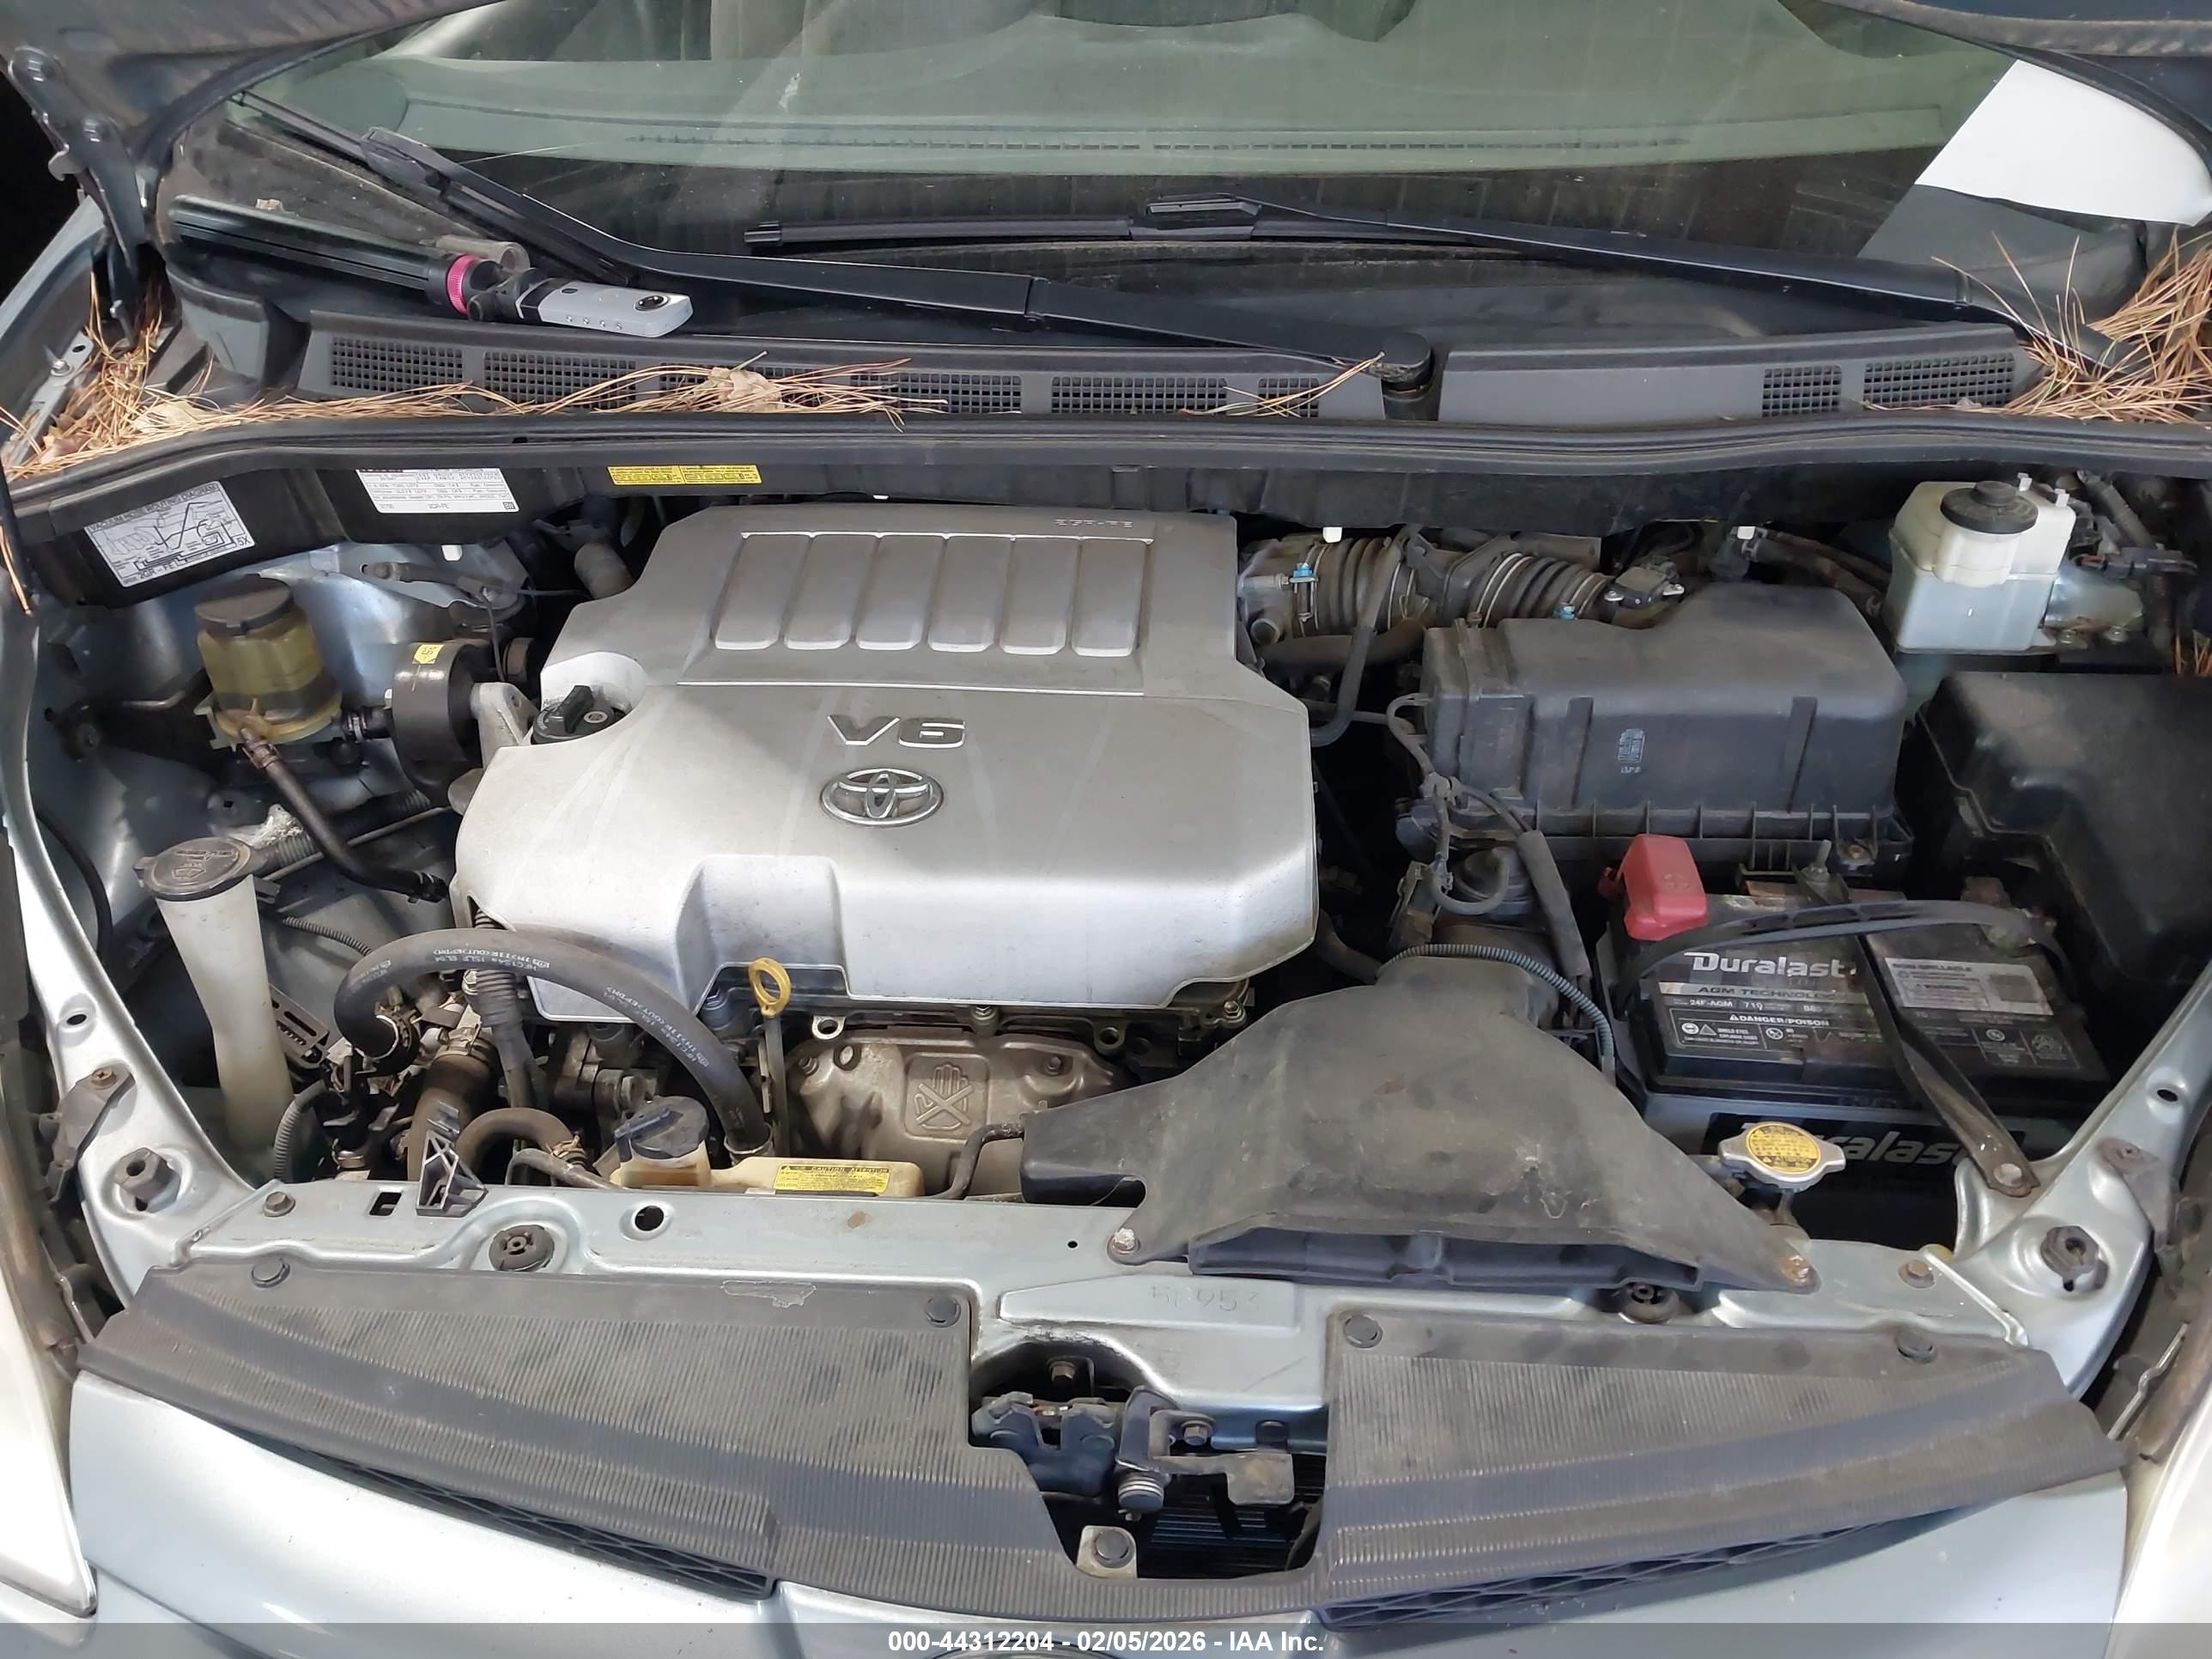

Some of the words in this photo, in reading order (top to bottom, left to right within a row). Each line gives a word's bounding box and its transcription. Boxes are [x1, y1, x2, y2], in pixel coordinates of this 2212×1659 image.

[237, 536, 251, 547] 5X
[827, 714, 967, 750] V6
[1684, 951, 1845, 978] Duralast
[1698, 986, 1735, 995] AGM
[1739, 1015, 1830, 1027] DANGER/POISON
